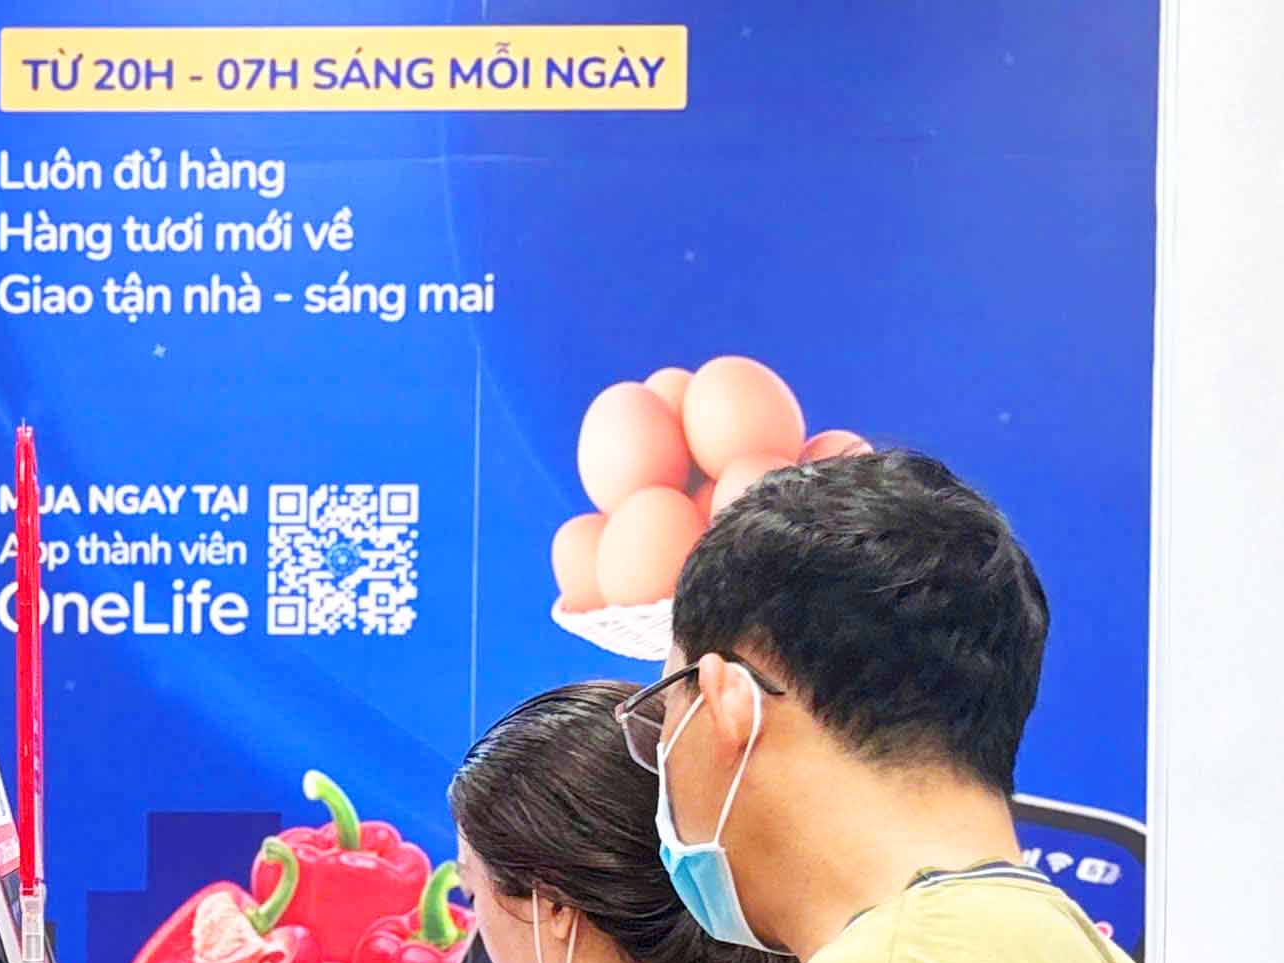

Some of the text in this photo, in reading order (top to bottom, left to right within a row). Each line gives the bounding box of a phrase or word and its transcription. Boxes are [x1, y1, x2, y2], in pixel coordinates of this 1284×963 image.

[22, 49, 83, 91] TỪ
[94, 58, 173, 91] 20H
[217, 58, 298, 90] 07H
[314, 48, 434, 90] SÁNG
[449, 43, 530, 89] MỖI
[546, 47, 665, 89] NGÀY
[0, 147, 286, 198] Luôn đủ hàng
[0, 207, 354, 258] Hàng tươi mới về
[102, 273, 172, 322] tận
[183, 272, 262, 314] nhà
[304, 271, 406, 322] sáng
[419, 273, 494, 313] mai
[88, 484, 186, 515] NGAY
[191, 484, 248, 522] TẠI
[76, 531, 172, 565] thành
[179, 532, 247, 565] viên
